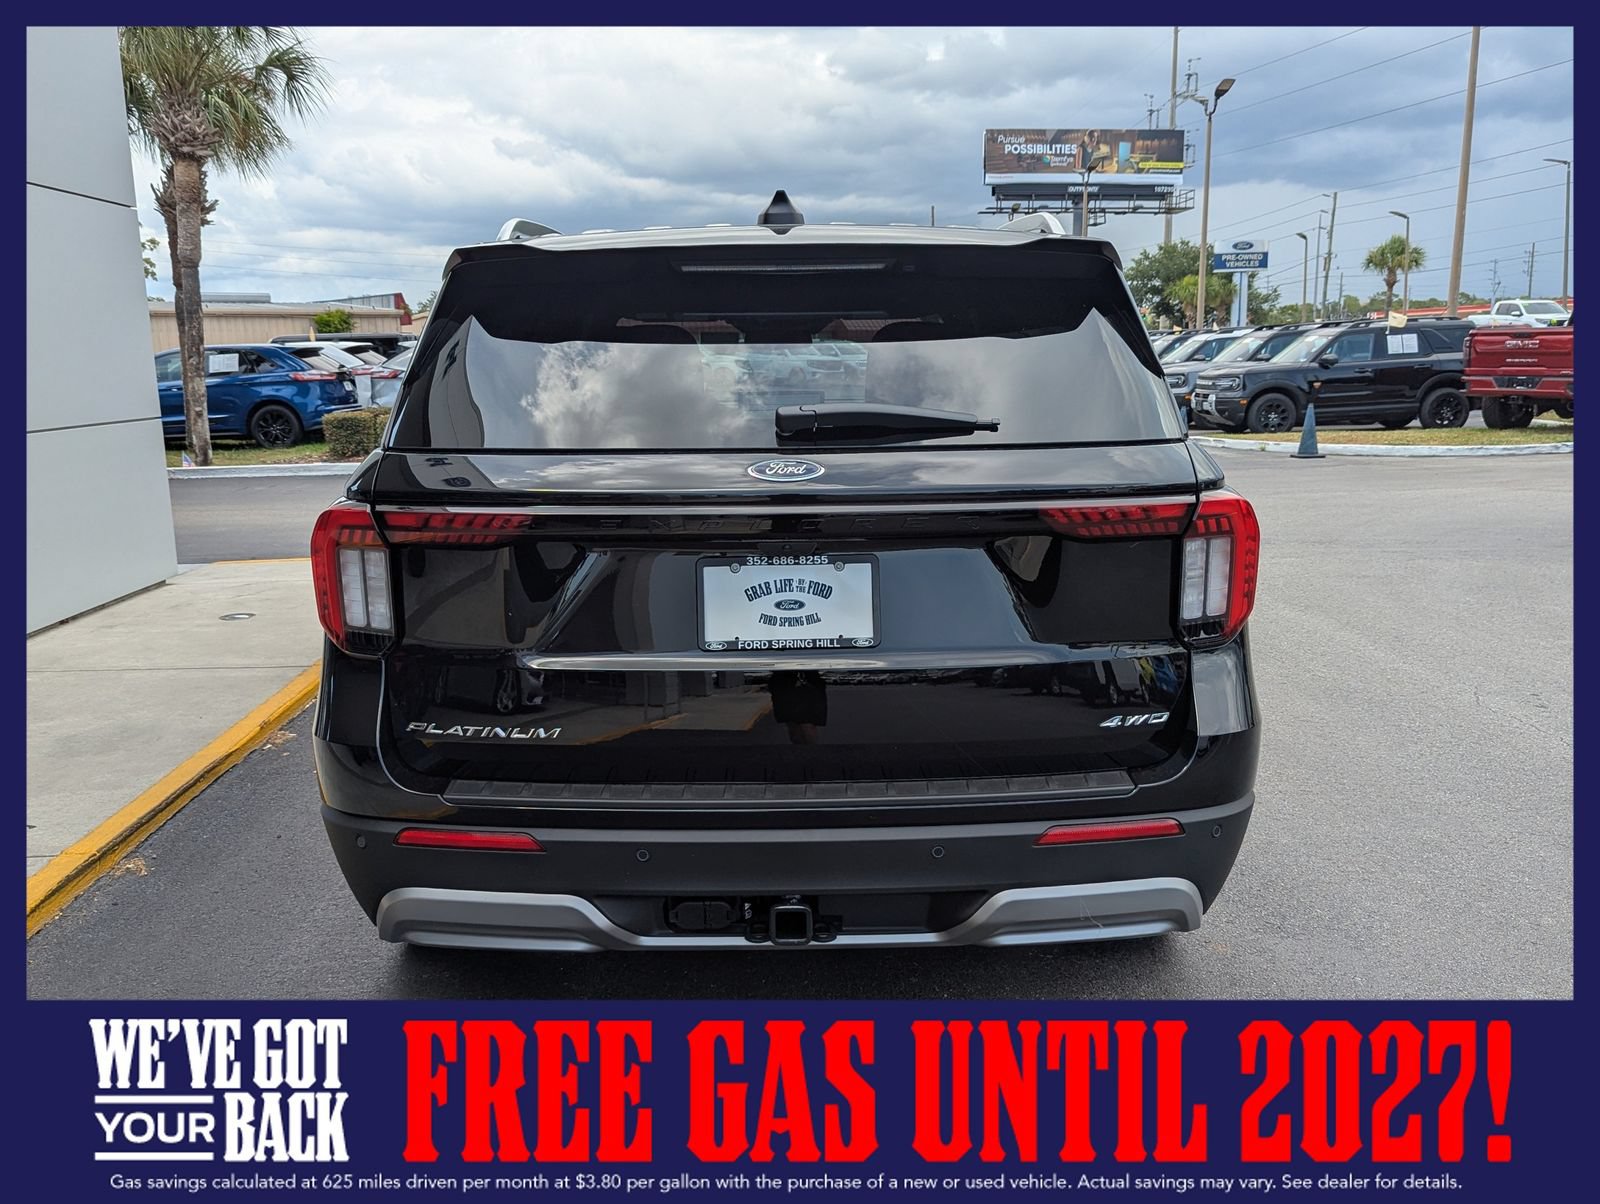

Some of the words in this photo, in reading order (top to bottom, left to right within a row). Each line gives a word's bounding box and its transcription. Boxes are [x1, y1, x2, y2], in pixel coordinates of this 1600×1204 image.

[997, 135, 1026, 144] Pursue
[1004, 144, 1077, 154] POSSIBILITIES
[1221, 253, 1263, 261] PRE-OWNED
[1225, 260, 1259, 268] VEHICLES
[766, 461, 806, 474] Ford
[746, 555, 829, 566] 352-686-8255
[744, 581, 773, 602] GRAB
[774, 578, 795, 594] LIFE
[807, 579, 833, 600] FORD
[758, 613, 778, 627] FORD
[778, 616, 804, 628] SPRING
[804, 612, 822, 626] HILL
[738, 640, 769, 650] FORD
[771, 639, 814, 649] SPRING
[816, 639, 841, 649] HILL
[1099, 711, 1170, 728] 4WD
[405, 721, 562, 739] PLATINUM
